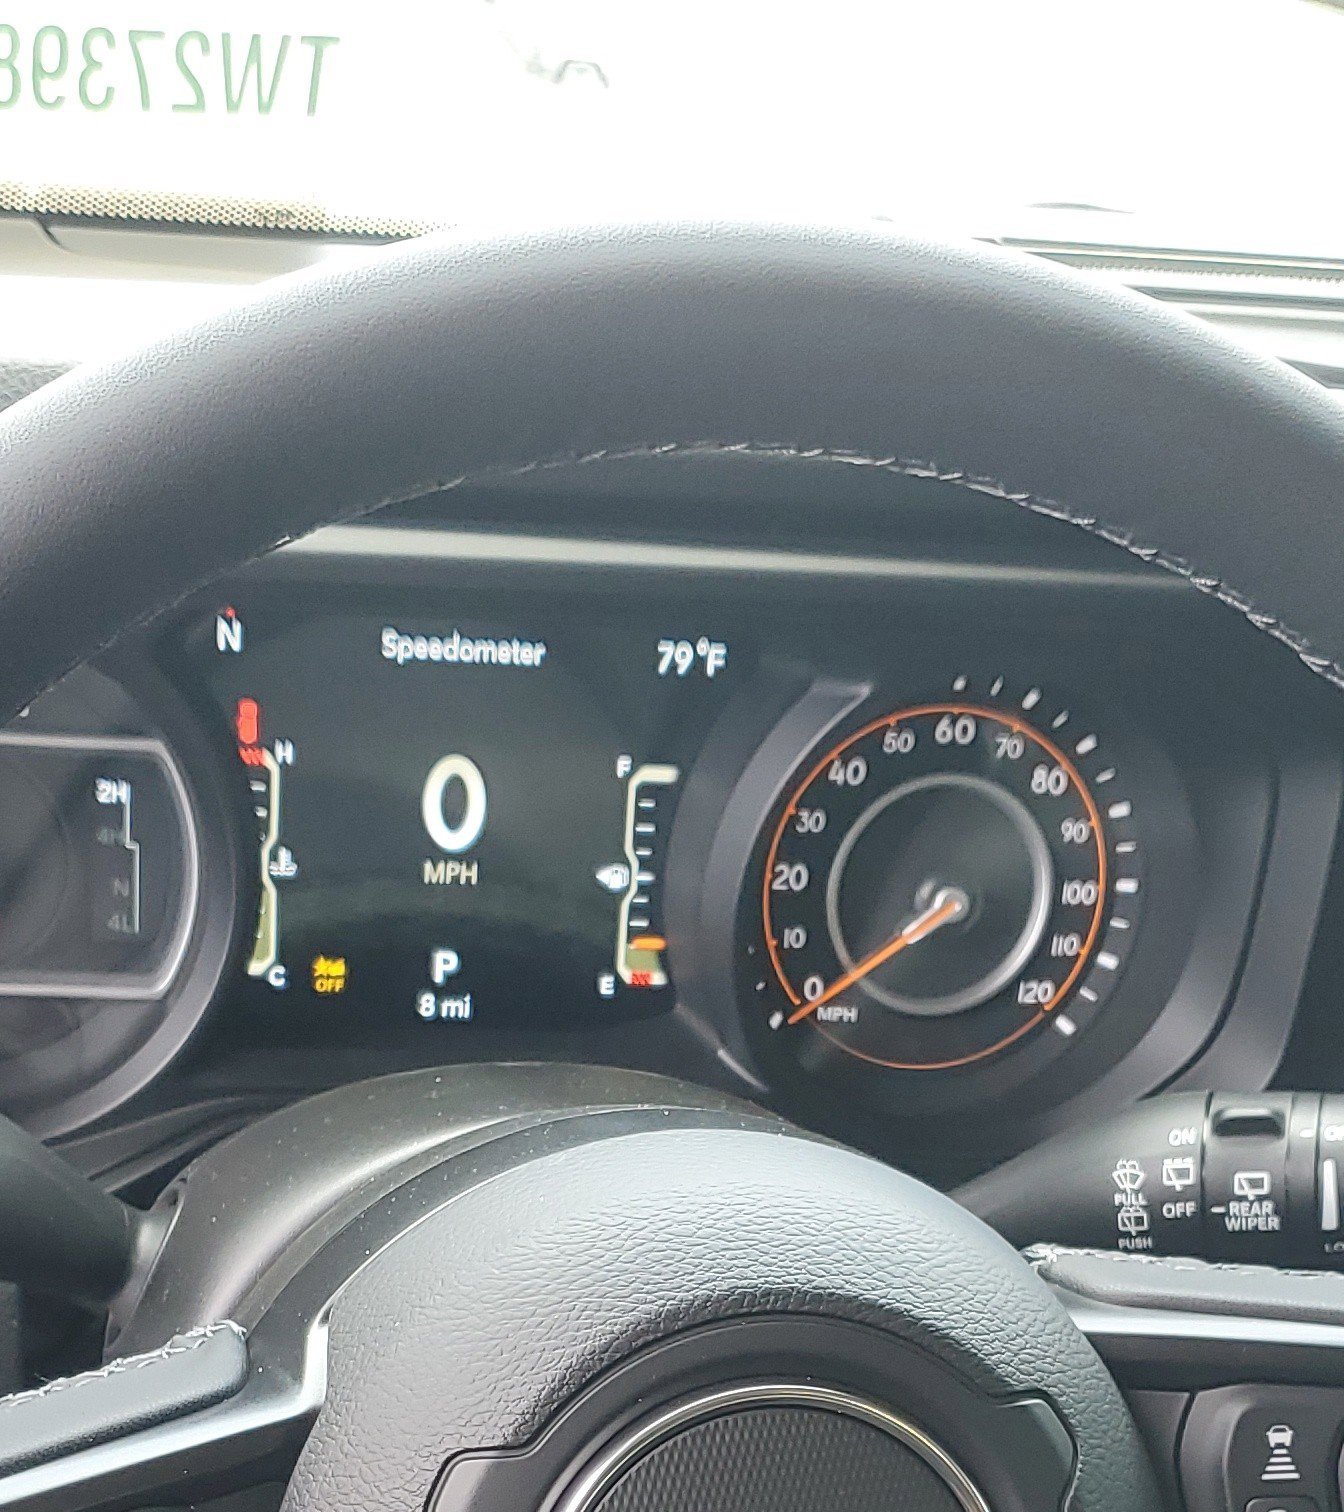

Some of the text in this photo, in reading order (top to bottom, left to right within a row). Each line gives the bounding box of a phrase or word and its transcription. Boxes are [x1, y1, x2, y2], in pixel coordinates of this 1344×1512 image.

[216, 614, 243, 652] N
[381, 625, 547, 667] Speedometer
[657, 636, 727, 678] 79°F
[882, 727, 916, 754] 50
[934, 716, 977, 746] 60
[274, 738, 296, 766] H
[994, 733, 1026, 760] 70
[616, 754, 633, 778] F
[827, 756, 868, 787] 40
[1031, 763, 1068, 796] 80
[422, 753, 487, 853] 0
[795, 807, 827, 834] 30
[1060, 816, 1090, 844] 90
[423, 859, 479, 885] MPH
[772, 862, 810, 892] 20
[1061, 879, 1099, 907] 100
[782, 925, 808, 950] 10
[1050, 932, 1079, 958] 110
[268, 964, 287, 988] C
[433, 948, 460, 984] P
[315, 977, 345, 993] OFF
[598, 972, 615, 996] E
[803, 974, 825, 1002] 0
[1017, 979, 1055, 1006] 120
[417, 991, 473, 1020] 8 mi
[816, 1005, 859, 1025] MPH
[1168, 1127, 1198, 1147] ON
[1113, 1192, 1148, 1207] PULL
[1162, 1201, 1197, 1219] OFF
[1228, 1200, 1276, 1217] REAR
[1224, 1214, 1282, 1232] WIPER
[1117, 1237, 1153, 1250] PUSH
